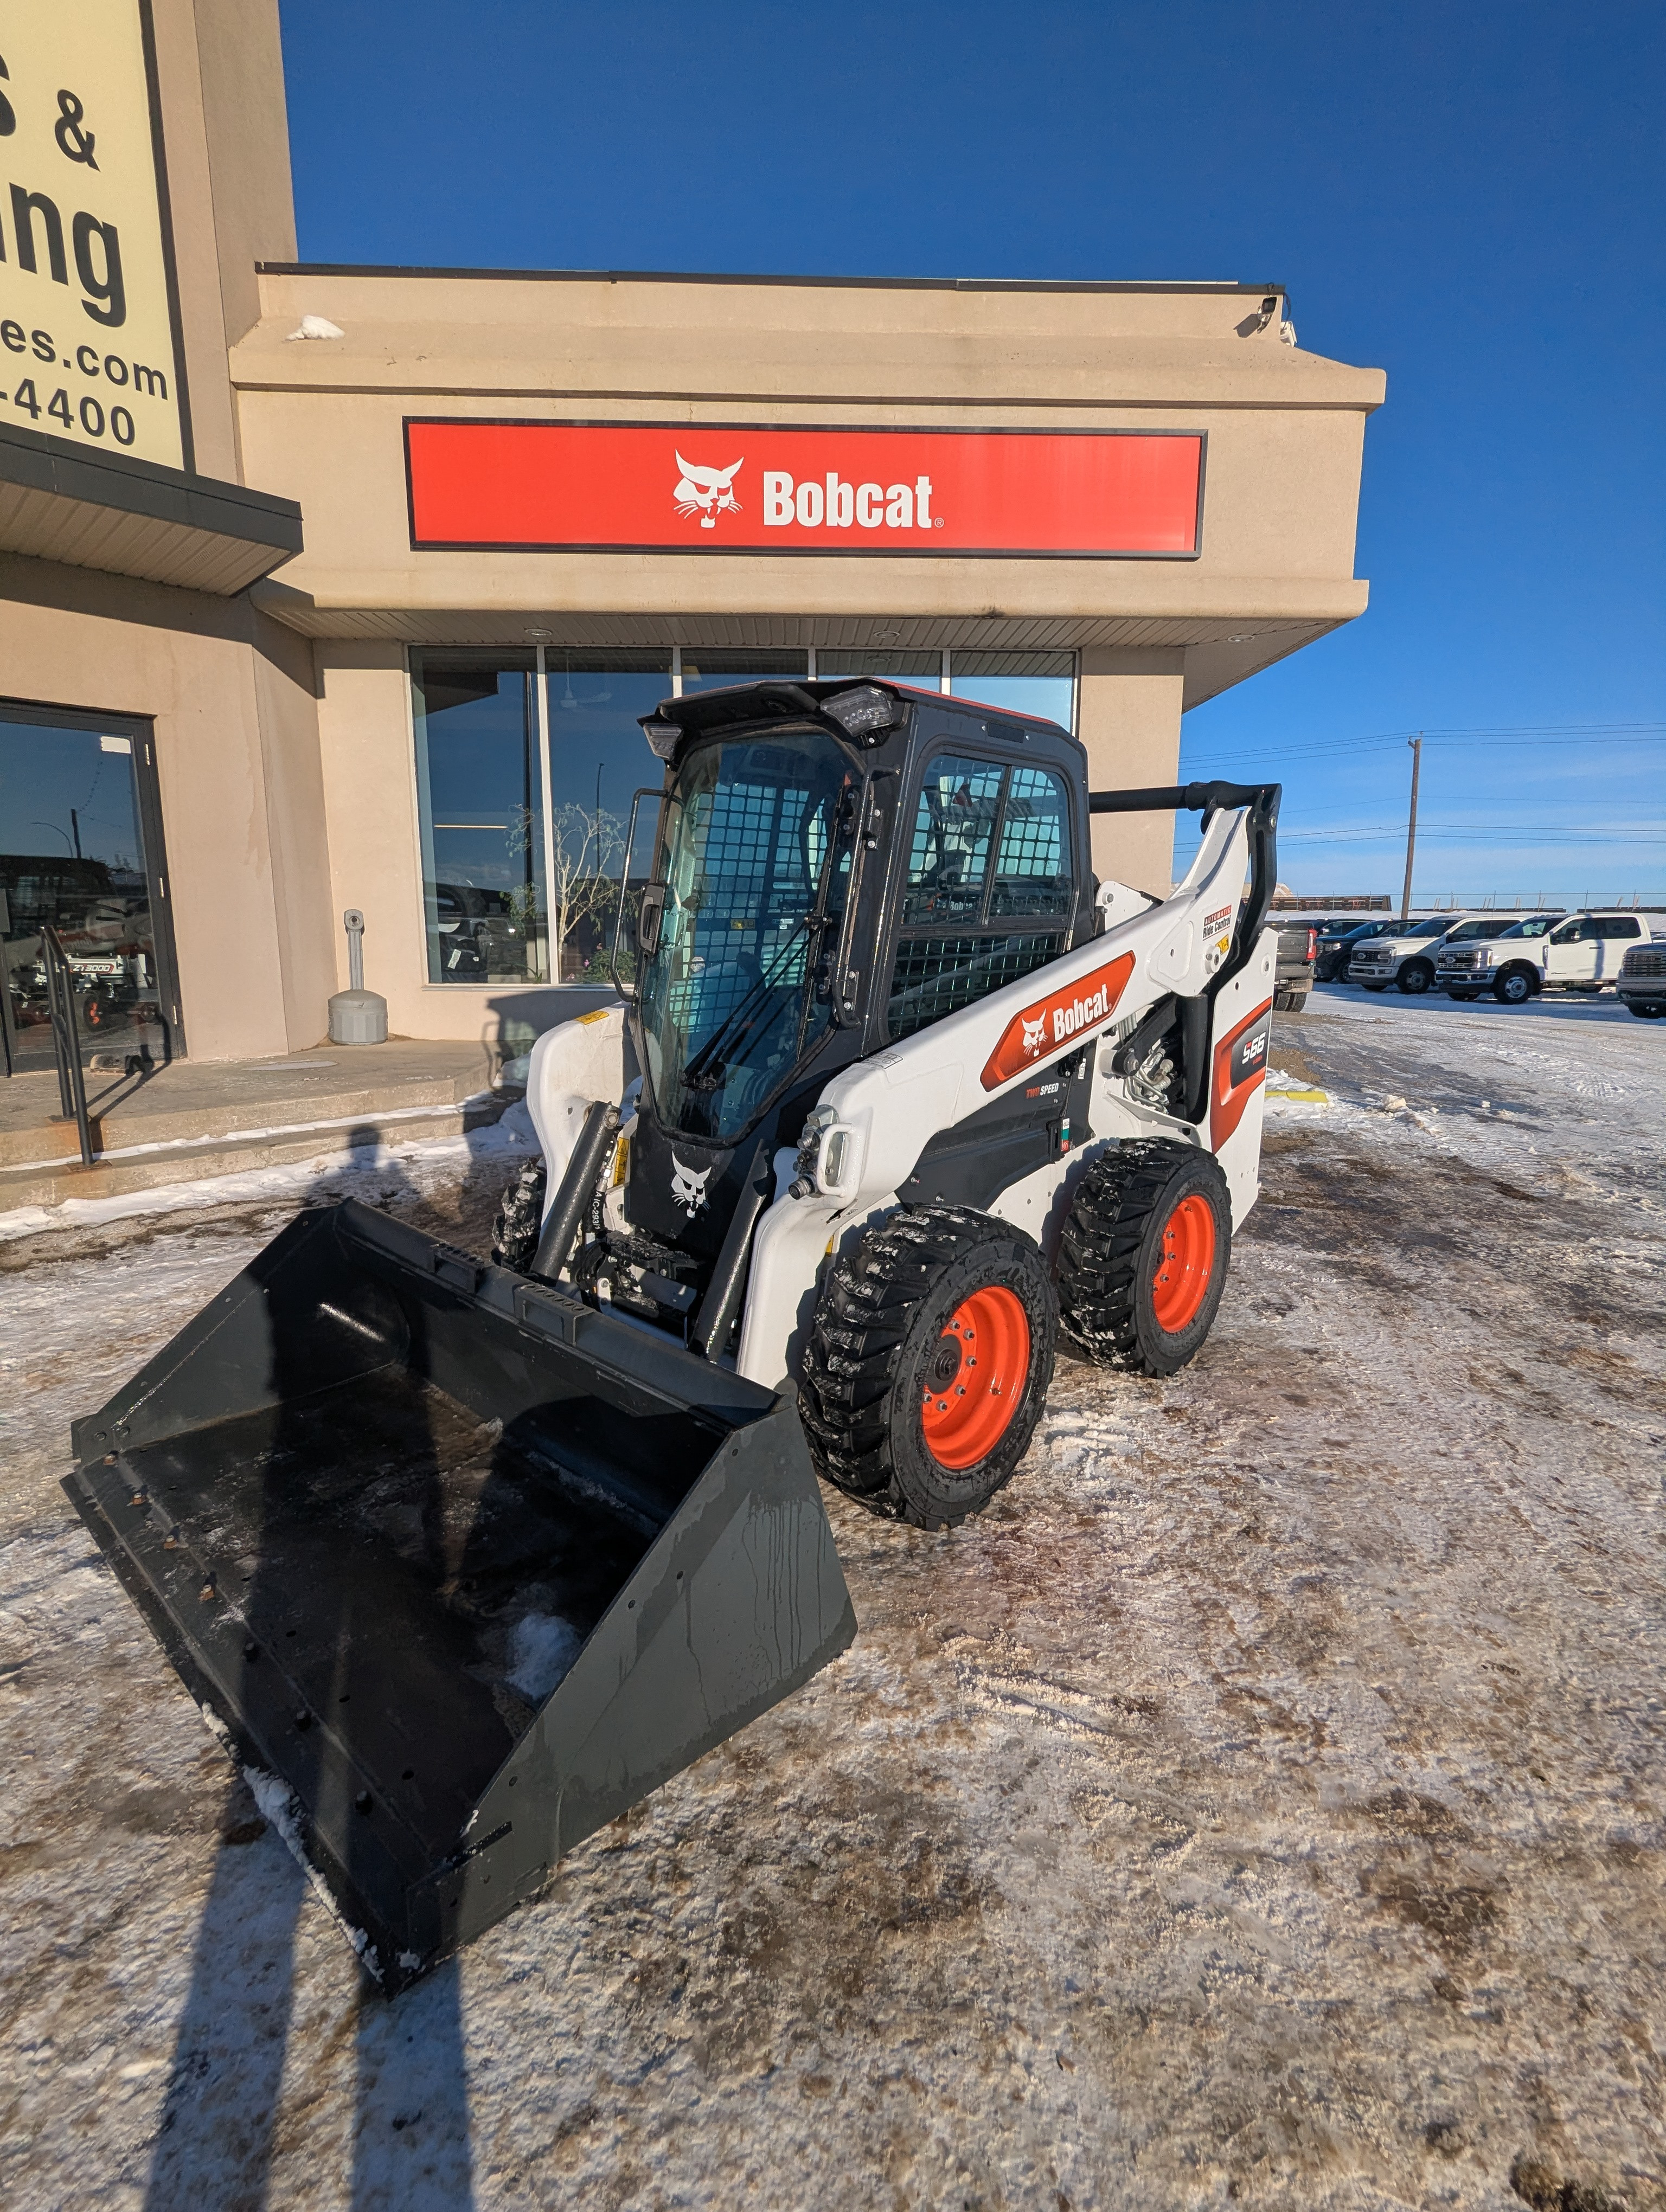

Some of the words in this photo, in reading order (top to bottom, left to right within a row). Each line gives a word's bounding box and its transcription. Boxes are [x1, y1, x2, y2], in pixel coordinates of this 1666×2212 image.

[55, 89, 101, 172] &
[0, 319, 168, 401] es.com
[764, 471, 932, 529] Bobcat
[1203, 925, 1214, 938] Ride
[1215, 915, 1231, 931] Control
[1204, 906, 1231, 925] AUTOMATIC
[1053, 983, 1108, 1042] Bobcat
[1242, 1032, 1266, 1064] S66
[1026, 1086, 1040, 1099] TWO
[1040, 1082, 1059, 1096] SPEED
